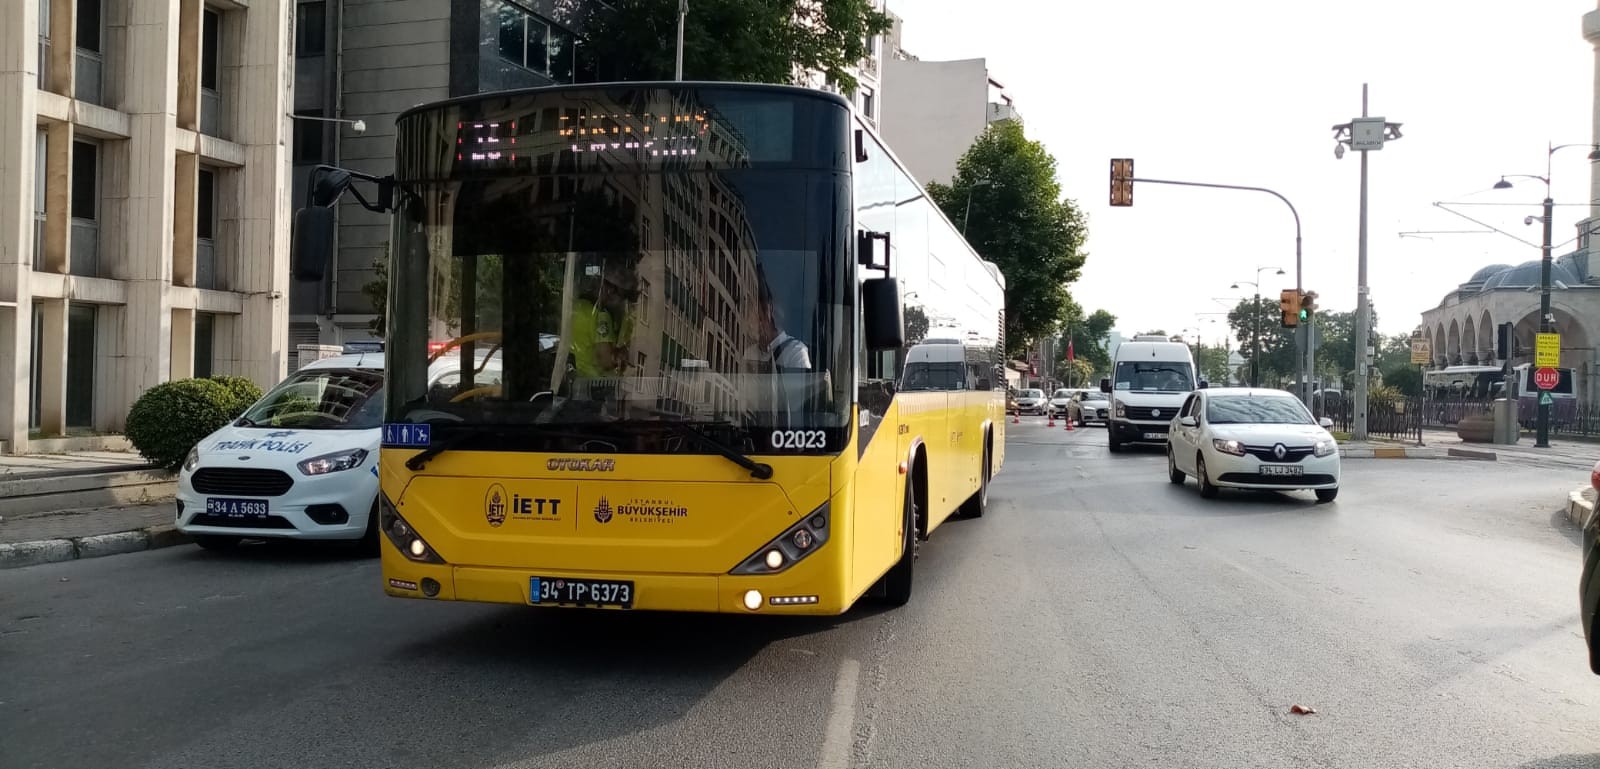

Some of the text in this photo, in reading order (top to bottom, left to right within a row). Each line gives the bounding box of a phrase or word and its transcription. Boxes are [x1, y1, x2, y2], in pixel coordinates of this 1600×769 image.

[1536, 373, 1557, 383] DUR
[547, 458, 615, 471] OTOKAR
[214, 501, 266, 515] 34 A 5633
[513, 493, 561, 515] İETT
[616, 503, 688, 519] BÜYÜKŞEHİR
[541, 581, 559, 599] 34
[567, 582, 585, 601] TP
[591, 583, 630, 602] 6373
